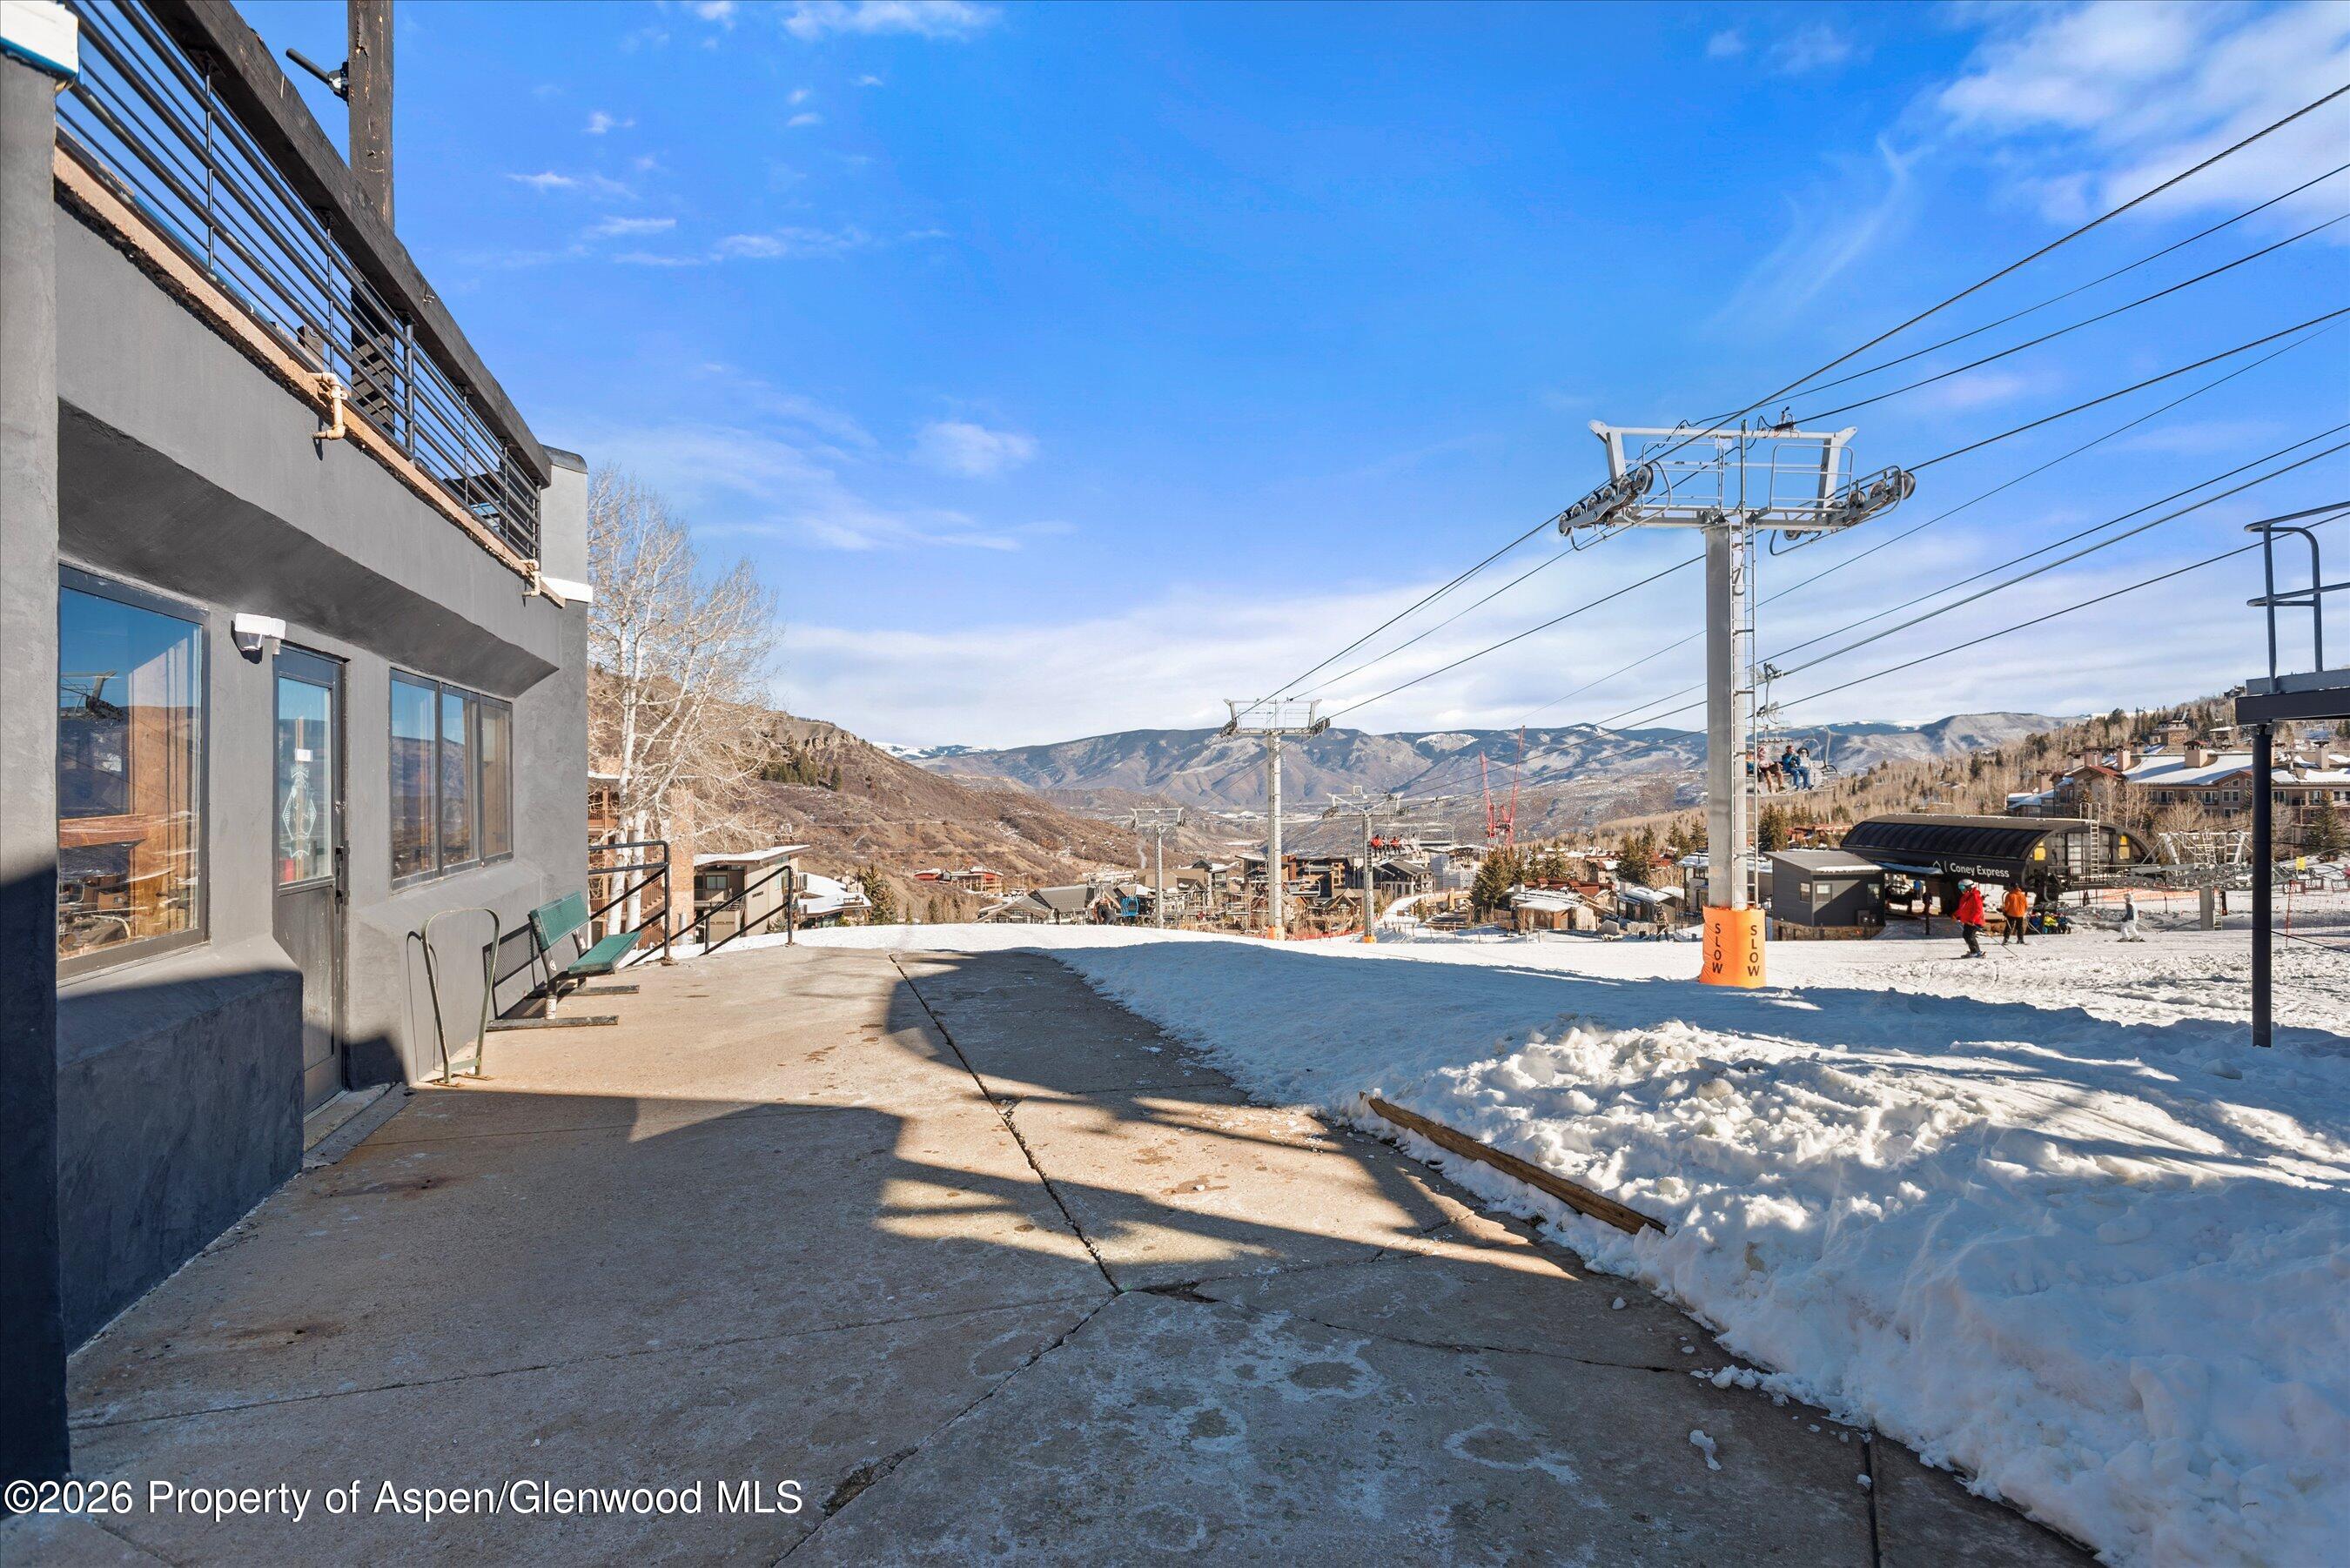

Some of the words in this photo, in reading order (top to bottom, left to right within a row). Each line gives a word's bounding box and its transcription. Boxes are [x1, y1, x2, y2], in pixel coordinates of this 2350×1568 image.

[1950, 862, 1975, 876] Coney
[1976, 865, 2010, 878] Express
[1712, 923, 1723, 974] SLOW
[1747, 924, 1760, 976] SLOW
